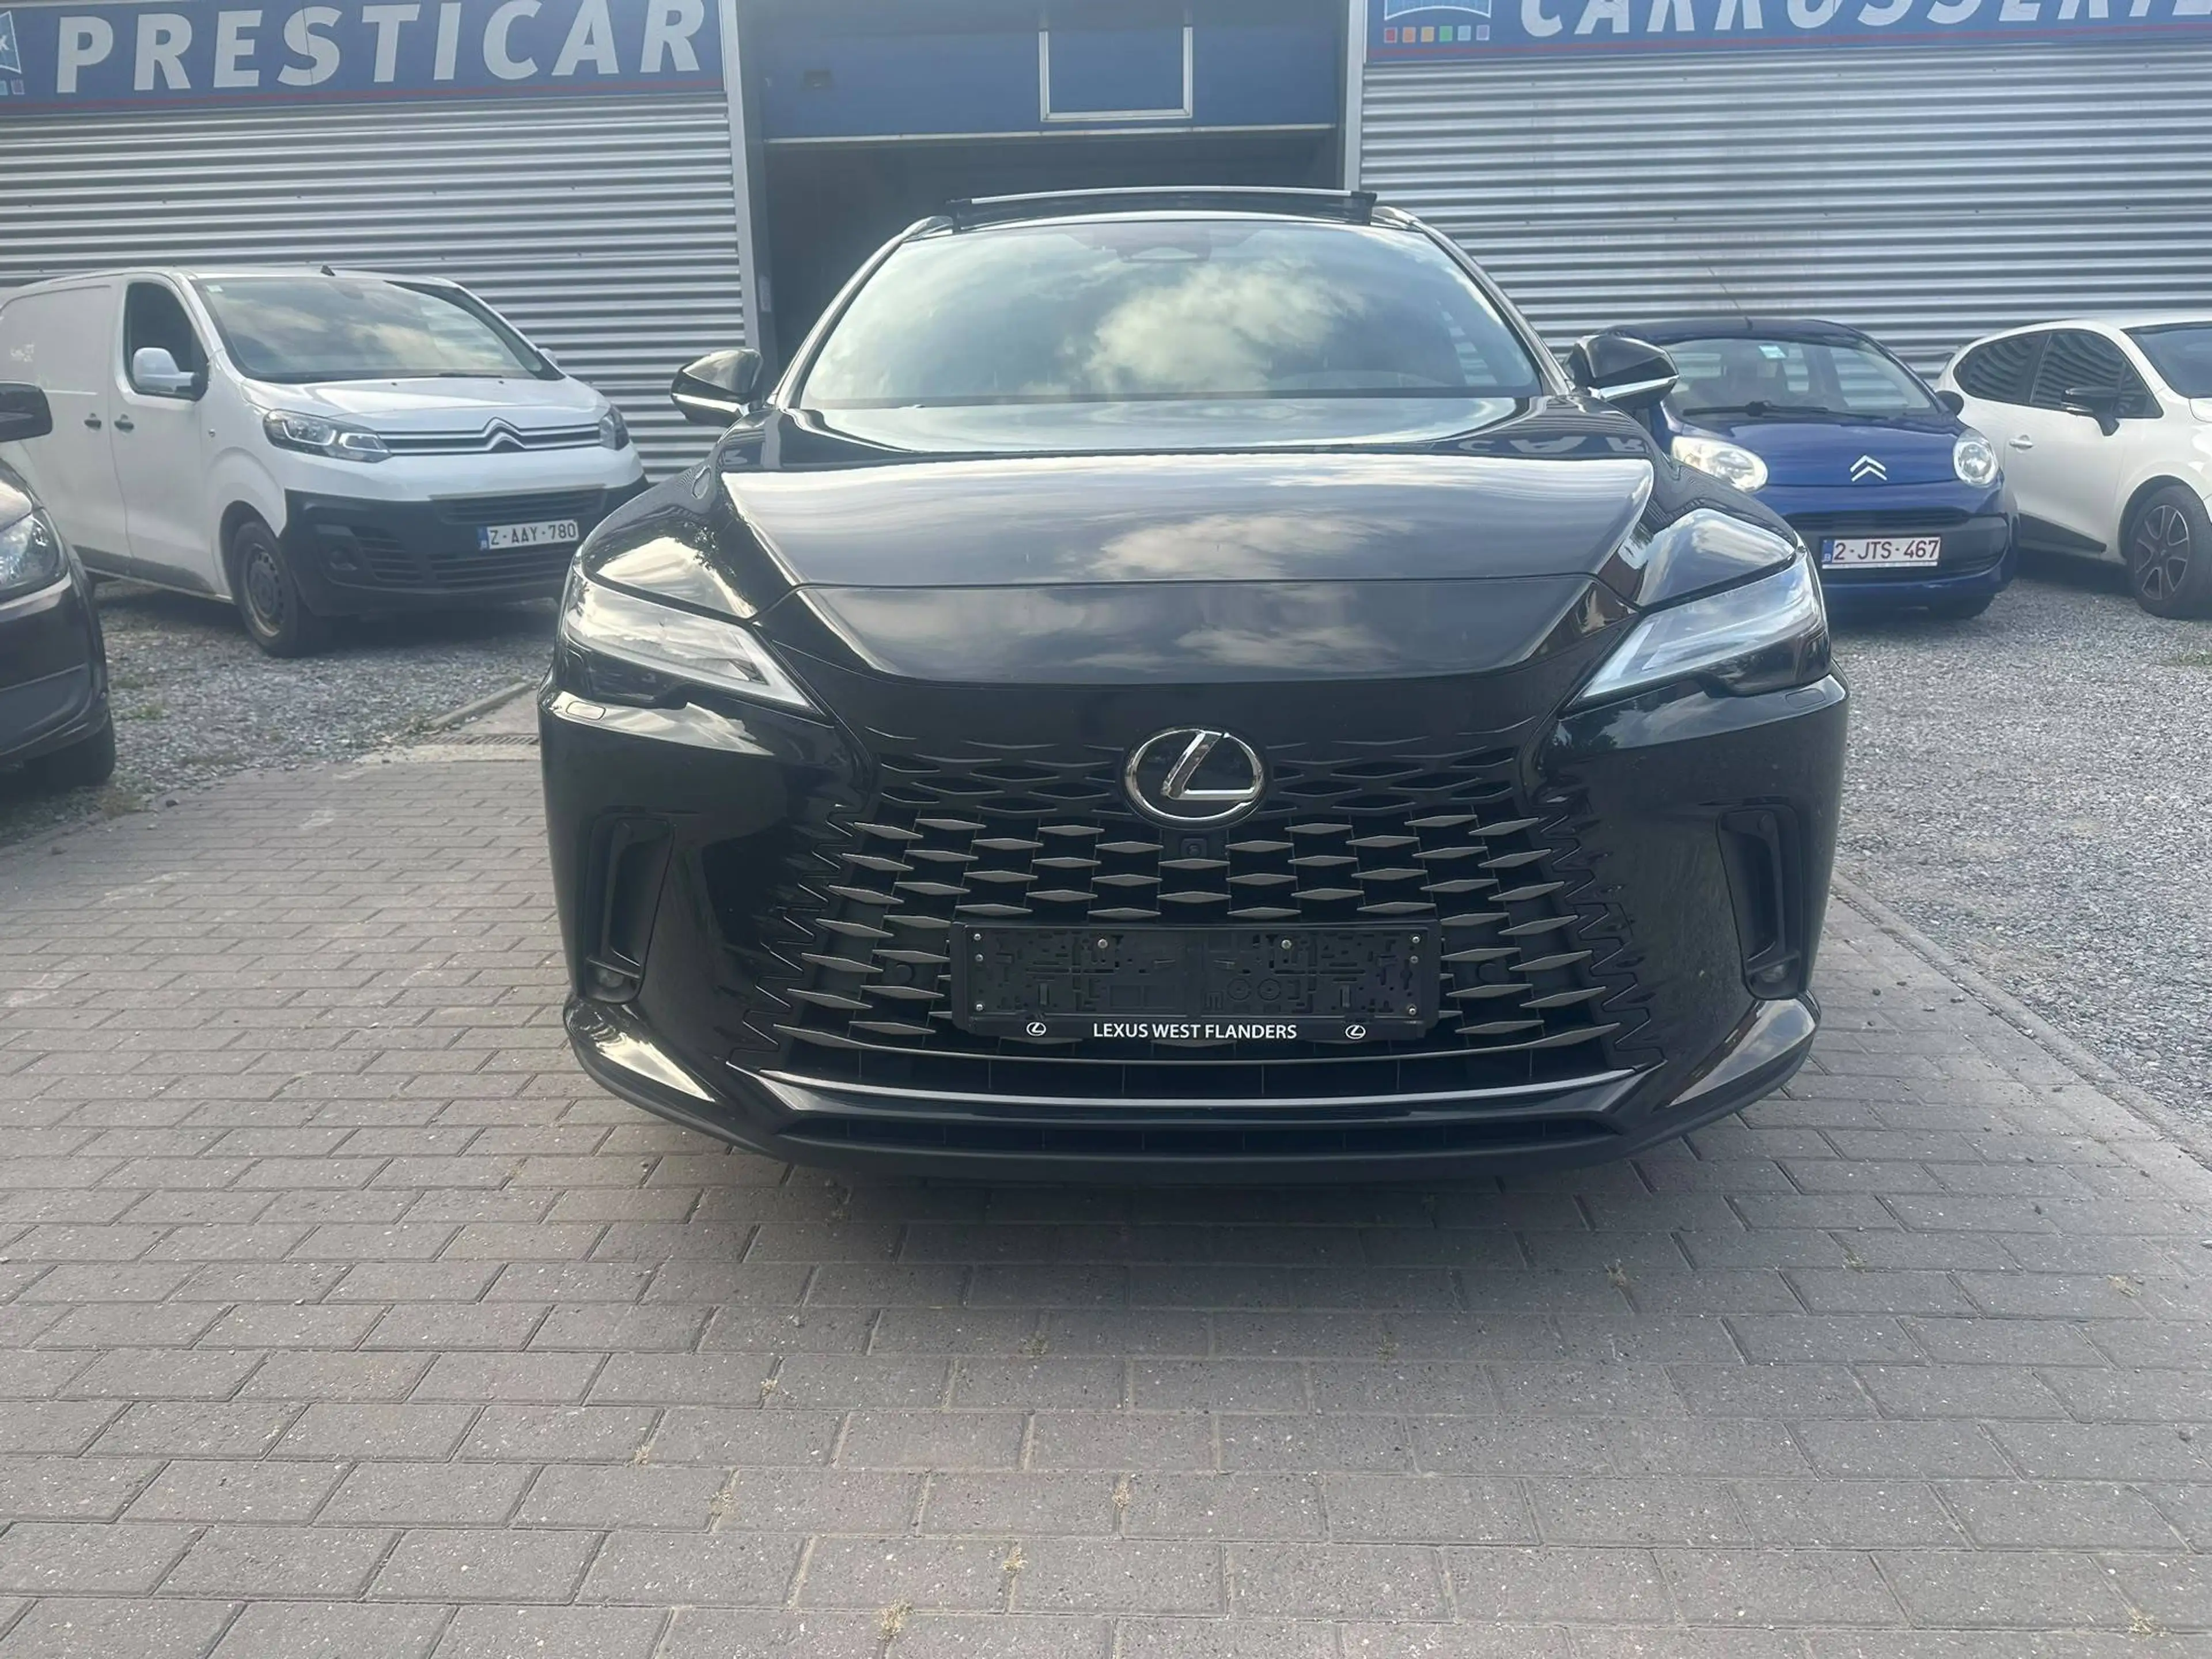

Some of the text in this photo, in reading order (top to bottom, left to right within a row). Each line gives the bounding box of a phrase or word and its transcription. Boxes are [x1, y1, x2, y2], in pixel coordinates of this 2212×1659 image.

[57, 0, 704, 93] PRESTICAR
[1094, 1022, 1297, 1039] LEXUS WEST FLANDERS
